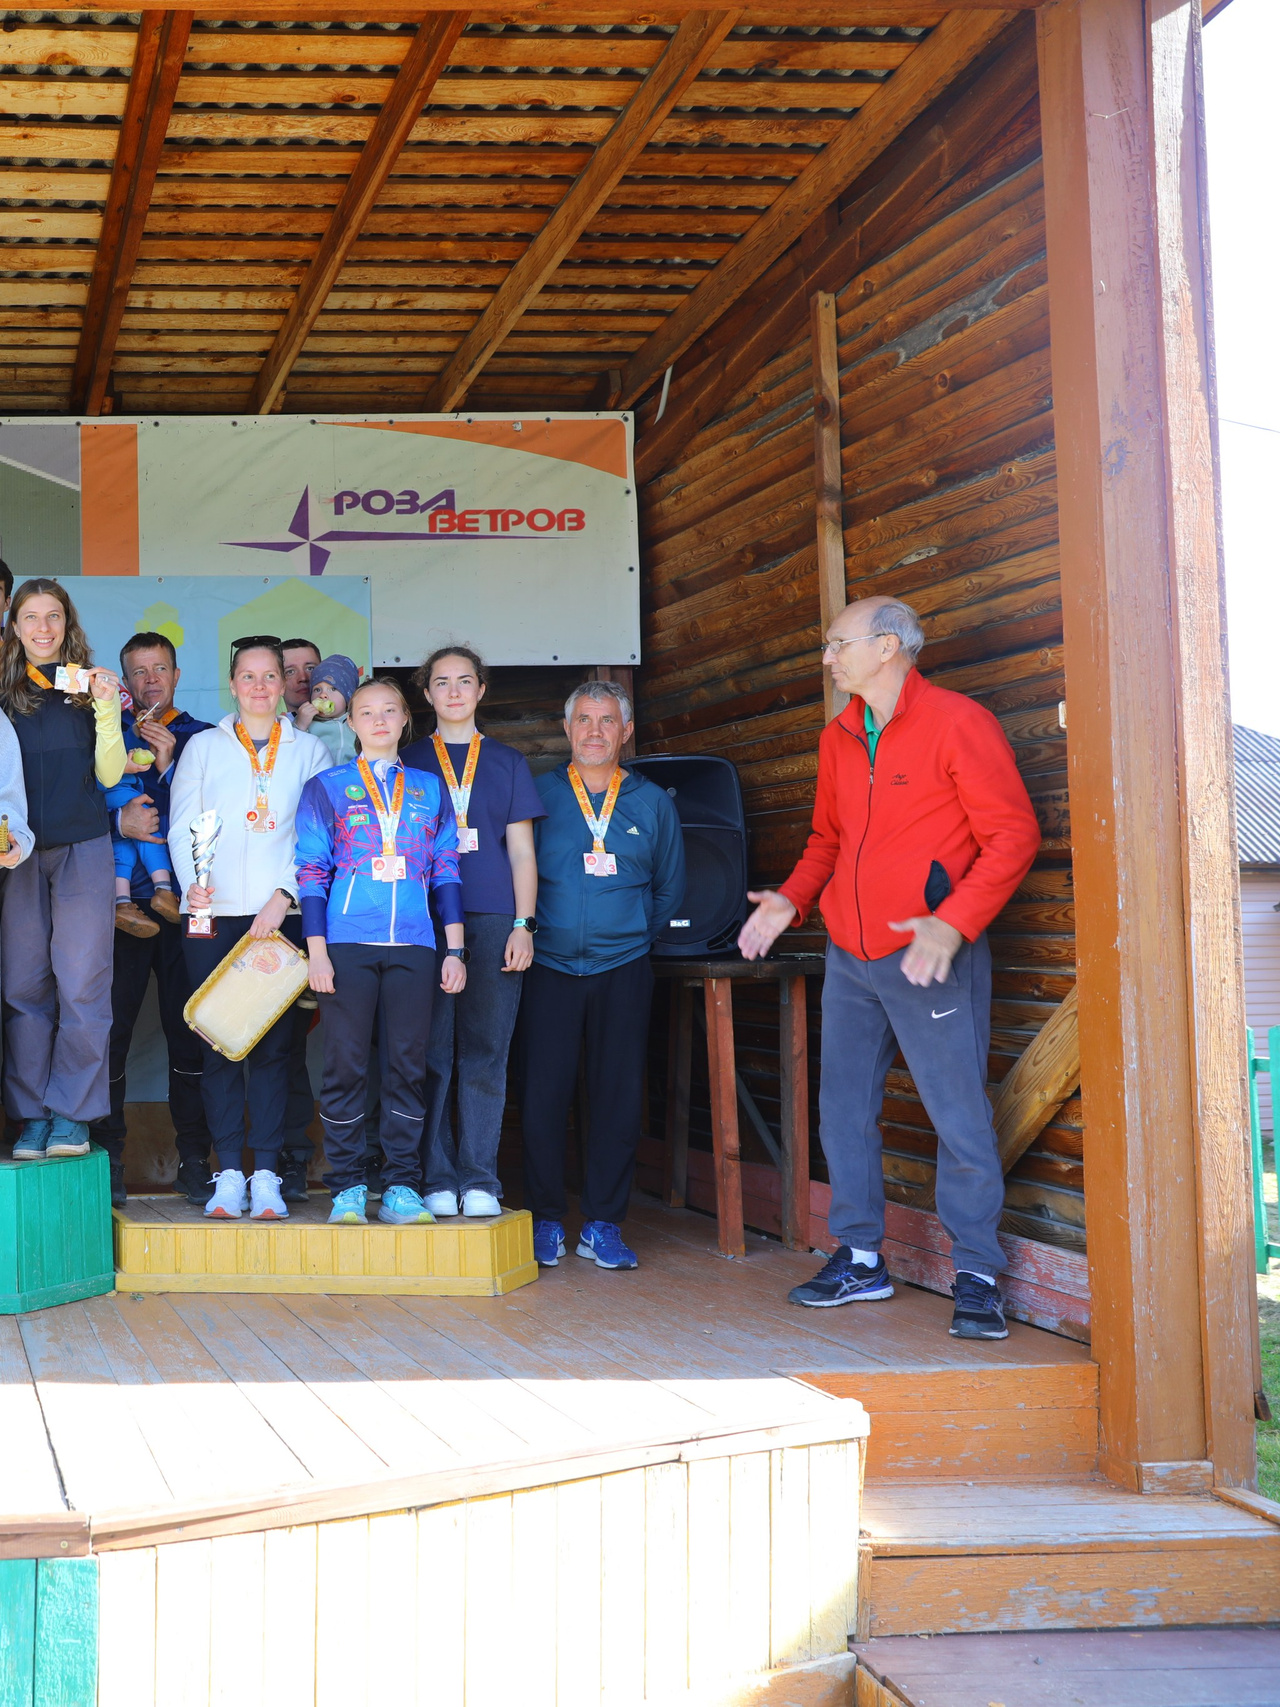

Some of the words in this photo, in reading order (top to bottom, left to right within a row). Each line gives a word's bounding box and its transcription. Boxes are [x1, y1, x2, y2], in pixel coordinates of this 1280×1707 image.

[333, 488, 456, 516] РОЗА
[428, 507, 586, 533] ВЕТРОВ
[267, 821, 275, 830] 3
[469, 840, 477, 849] 3
[396, 868, 405, 877] 3
[609, 864, 616, 873] 3
